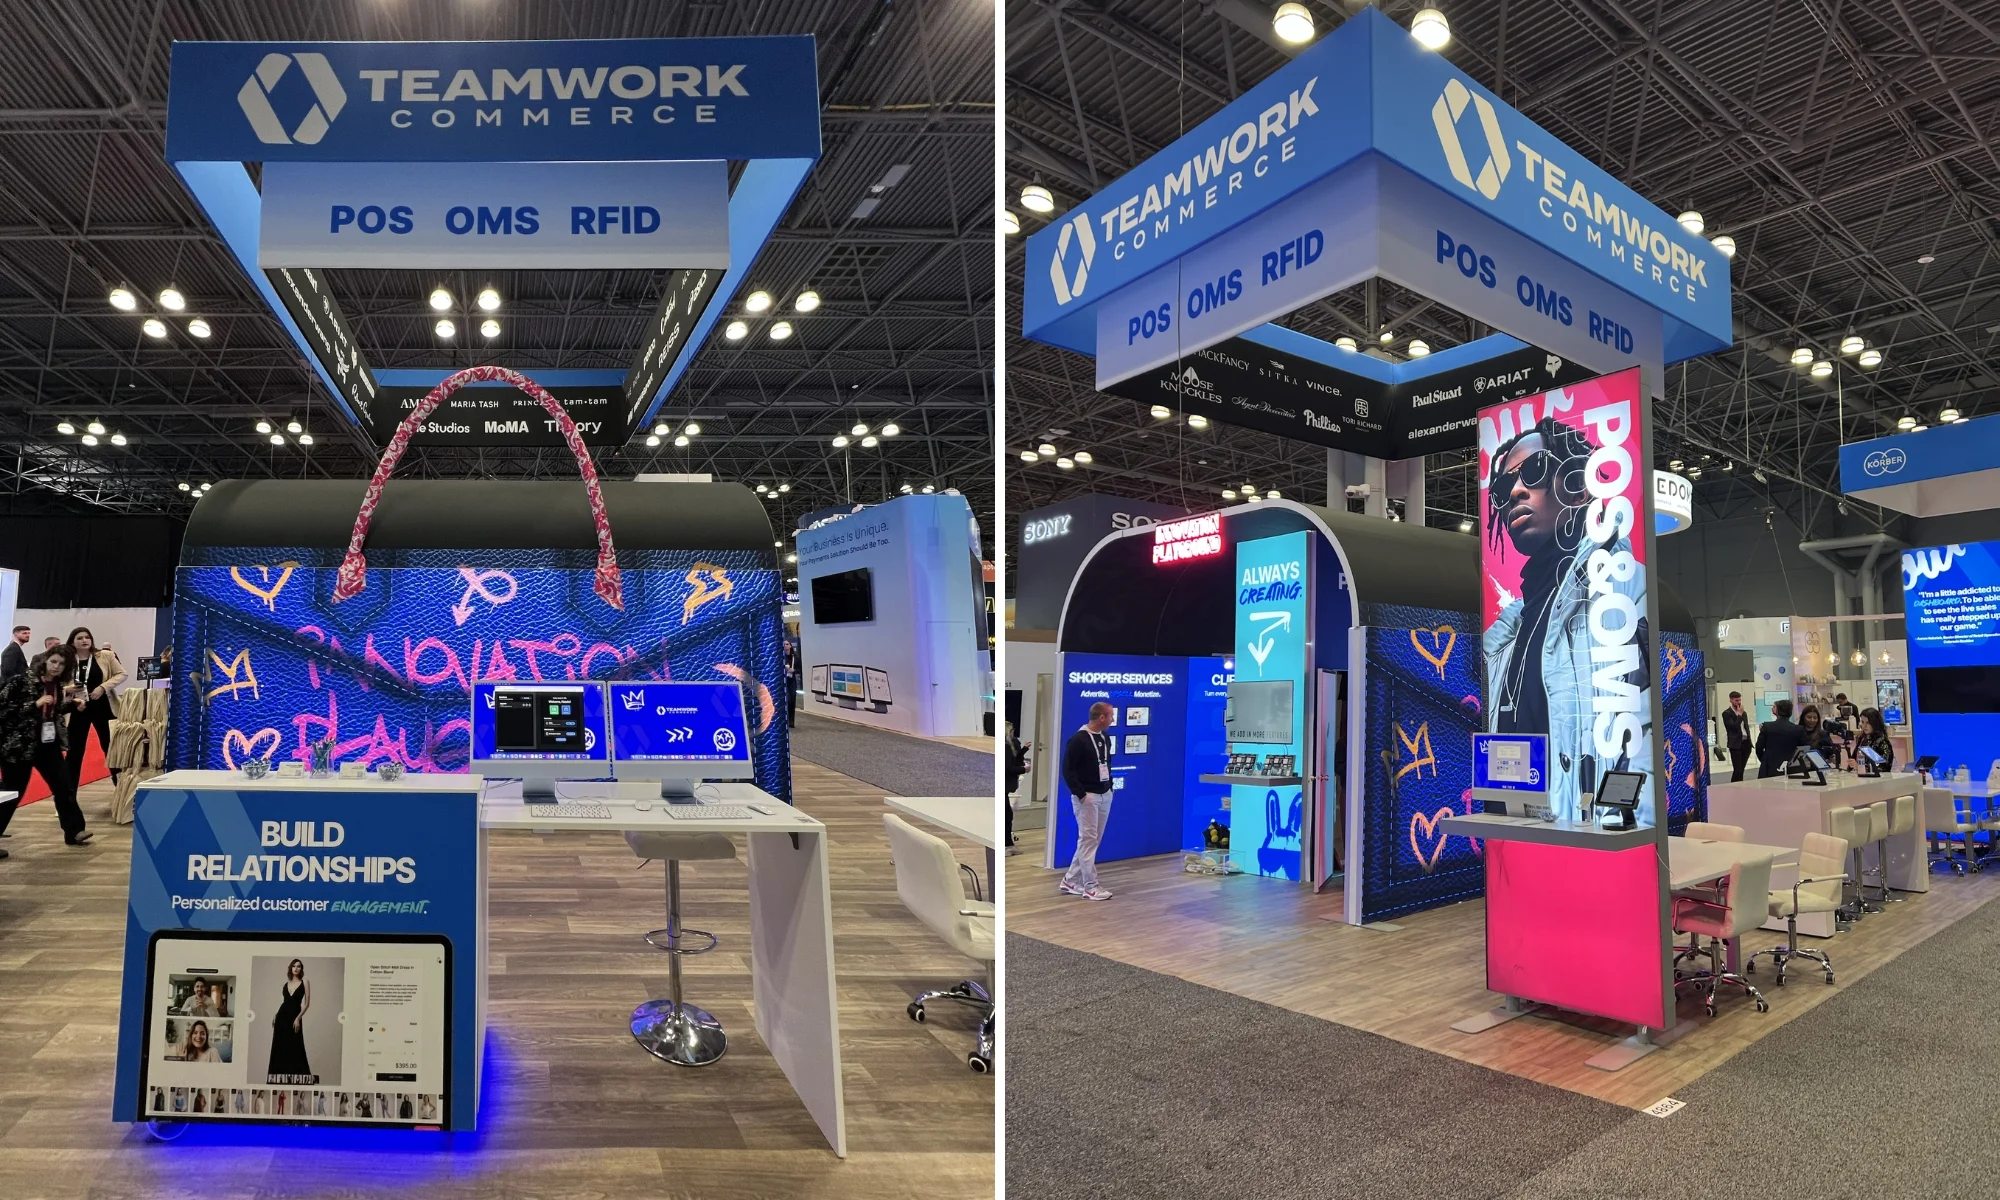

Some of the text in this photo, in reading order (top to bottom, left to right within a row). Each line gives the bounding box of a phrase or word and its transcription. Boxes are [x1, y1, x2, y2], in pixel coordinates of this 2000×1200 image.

[359, 64, 750, 102] TEAMWORK
[391, 104, 717, 128] COMMERCE
[1101, 75, 1319, 242] TEAMWORK
[1114, 136, 1296, 260] COMMERCE
[330, 204, 661, 235] POS OMS RFID
[1516, 140, 1708, 288] TEAMWORK
[1539, 196, 1696, 302] COMMERCE
[1128, 229, 1324, 346] POS OMS RFID
[1436, 229, 1634, 355] POS OMS RFID
[1487, 368, 1531, 389] ARIAT
[1160, 379, 1222, 404] KNUCKLES
[1412, 385, 1462, 408] Paul Stuart
[479, 400, 499, 408] TASH
[428, 421, 470, 433] Studios
[484, 421, 529, 433] MoMA
[1303, 409, 1341, 433] Phillies
[1342, 416, 1355, 425] TORI
[1357, 420, 1382, 431] RICHARD
[1867, 456, 1903, 469] KÖRBER
[814, 534, 844, 552] Business
[855, 522, 889, 539] Unique.
[1024, 514, 1072, 544] SONY
[809, 553, 829, 565] Payments
[830, 548, 849, 559] Solution
[850, 543, 868, 554] Should
[1242, 561, 1300, 586] ALWAYS
[1957, 586, 1991, 595] addicted
[1936, 615, 1956, 624] really
[1958, 612, 1990, 622] stepped
[1069, 672, 1173, 684] SHOPPER SERVICES
[1080, 690, 1109, 698] Advertise,
[1134, 690, 1161, 698] Monetize.
[1252, 731, 1265, 739] MORE
[261, 820, 344, 848] BUILD
[187, 854, 416, 884] RELATIONSHIPS
[171, 895, 260, 911] Personalized
[262, 898, 329, 912] customer
